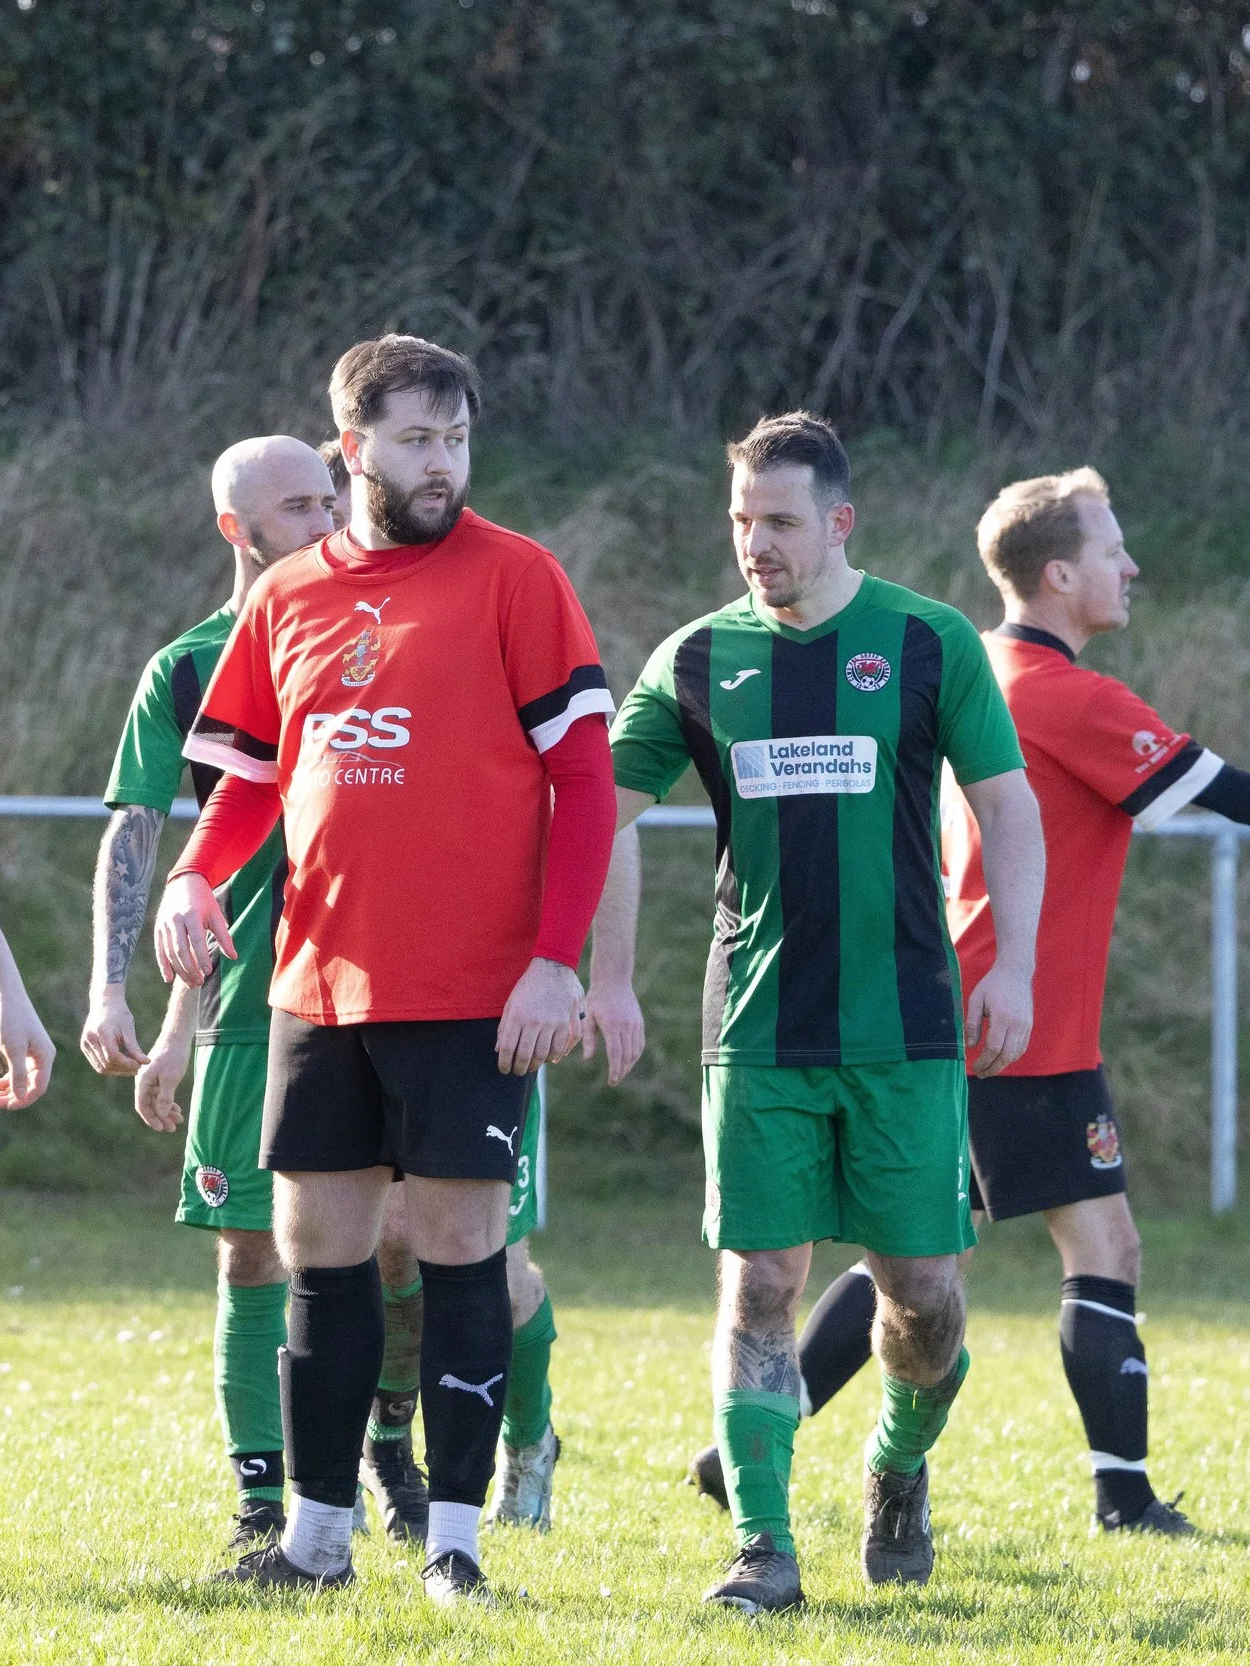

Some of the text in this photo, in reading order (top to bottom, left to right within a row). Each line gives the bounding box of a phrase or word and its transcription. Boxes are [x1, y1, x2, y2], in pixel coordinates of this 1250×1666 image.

[769, 741, 853, 760] Lakeland
[334, 767, 405, 785] CENTRE
[770, 758, 872, 776] Verandahs
[740, 779, 871, 794] DECKING FENCING PERGOLAS
